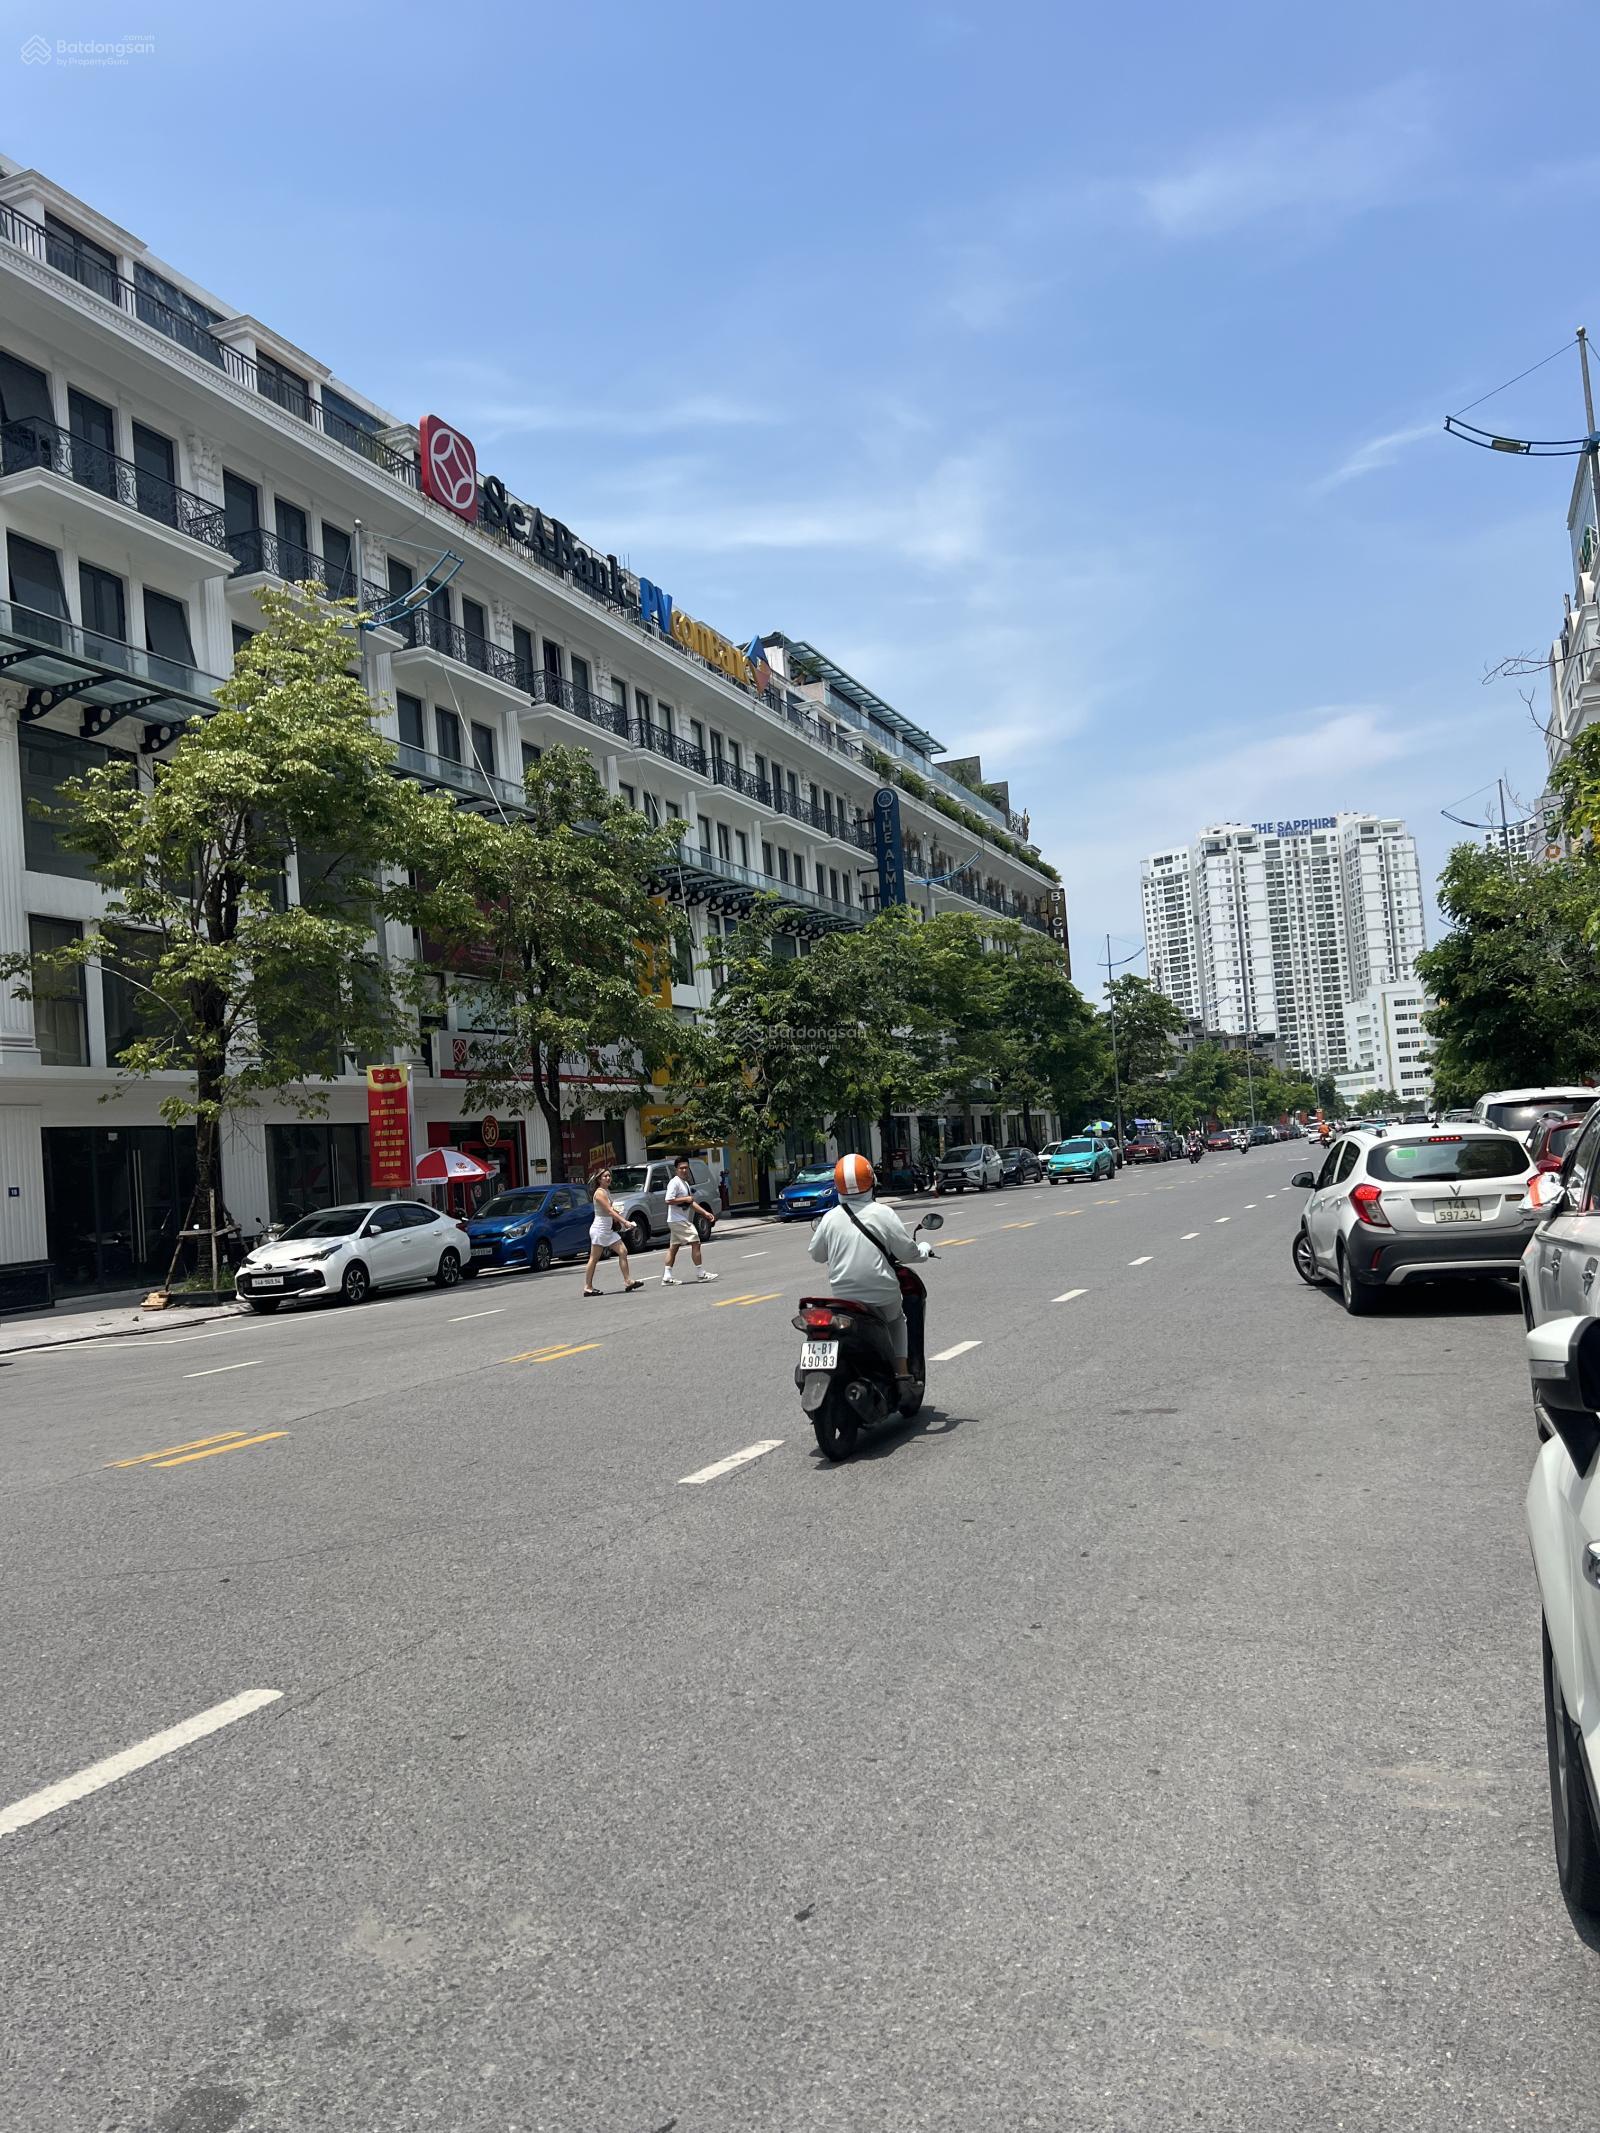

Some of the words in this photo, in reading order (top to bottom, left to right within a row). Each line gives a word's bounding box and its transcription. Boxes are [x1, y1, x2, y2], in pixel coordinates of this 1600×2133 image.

[483, 475, 632, 608] SeABank
[881, 809, 894, 844] THE
[1251, 822, 1274, 835] THE
[1277, 817, 1338, 832] SAPPHIRE
[1447, 1200, 1467, 1209] 14A
[1439, 1209, 1477, 1221] 597.34
[807, 1342, 832, 1355] 14-B1
[801, 1355, 835, 1368] 490.83
